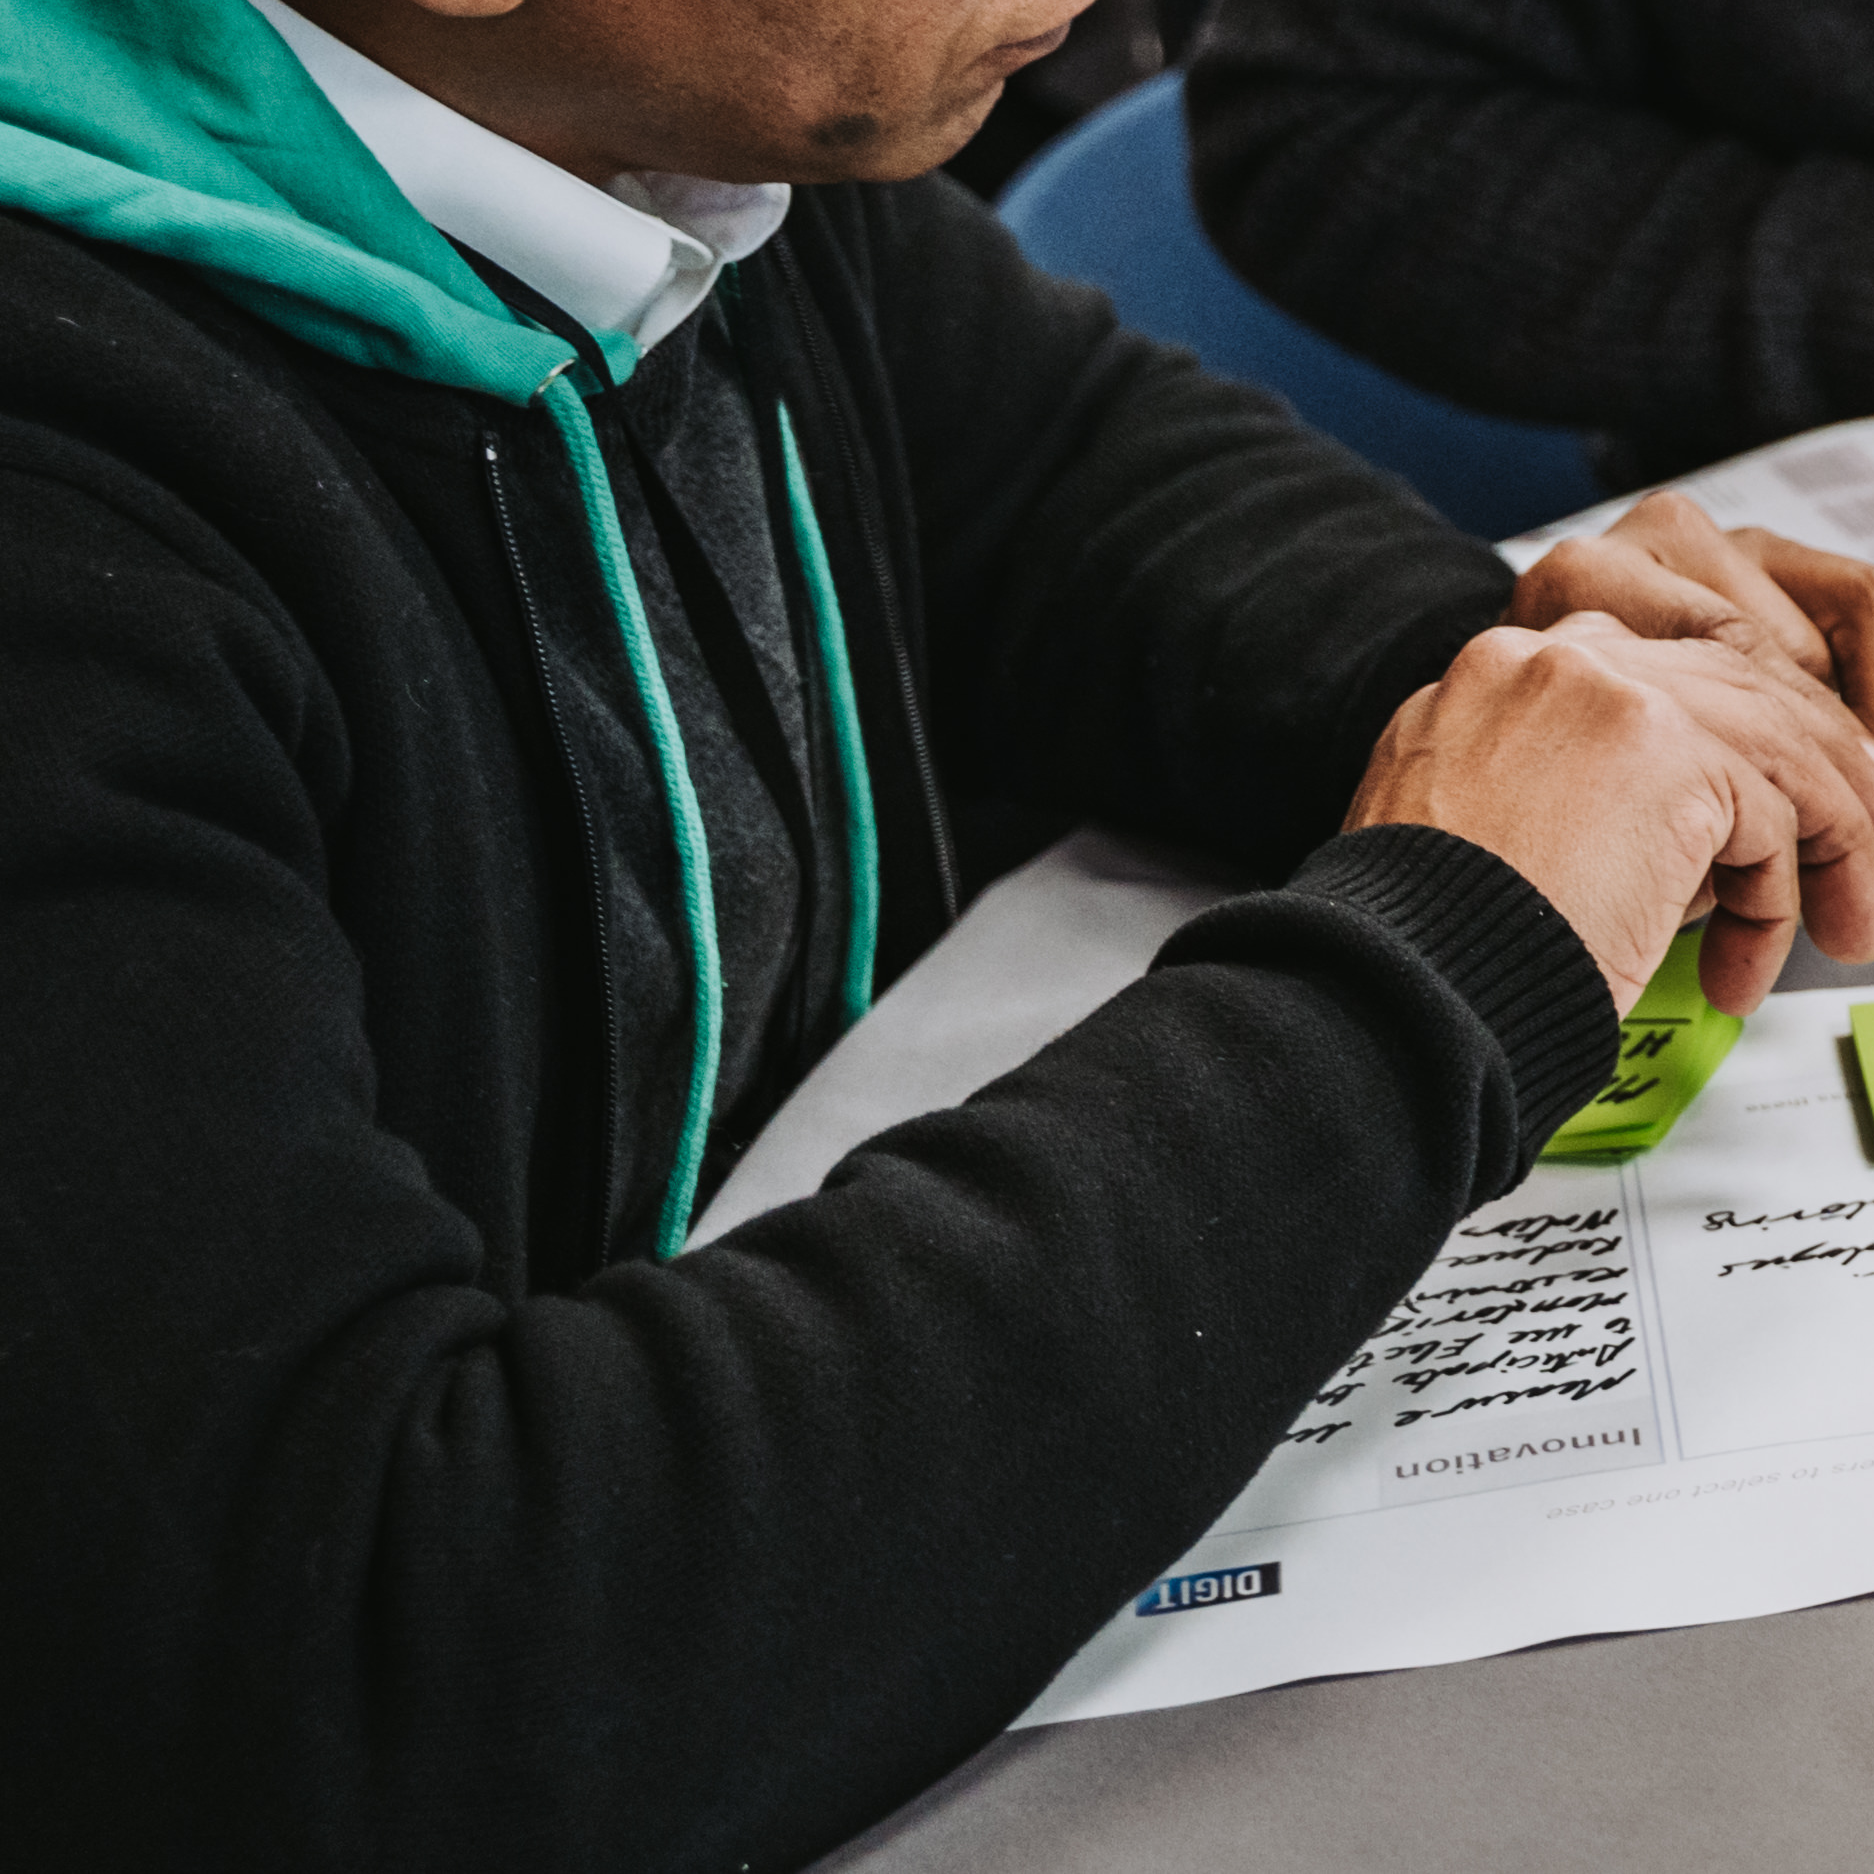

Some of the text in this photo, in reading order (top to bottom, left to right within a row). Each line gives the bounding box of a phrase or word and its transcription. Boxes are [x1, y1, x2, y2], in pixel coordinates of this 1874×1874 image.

[1506, 1323, 1582, 1344] use
[1604, 1317, 1633, 1335] to
[1392, 1337, 1635, 1395] Anticipate
[1393, 1368, 1637, 1428] Measure
[1394, 1427, 1642, 1481] Innovation
[1690, 1471, 1781, 1500] select
[1791, 1465, 1820, 1485] to
[1544, 1498, 1616, 1523] case
[1626, 1488, 1681, 1509] one
[1153, 1569, 1263, 1610] DIGIT
